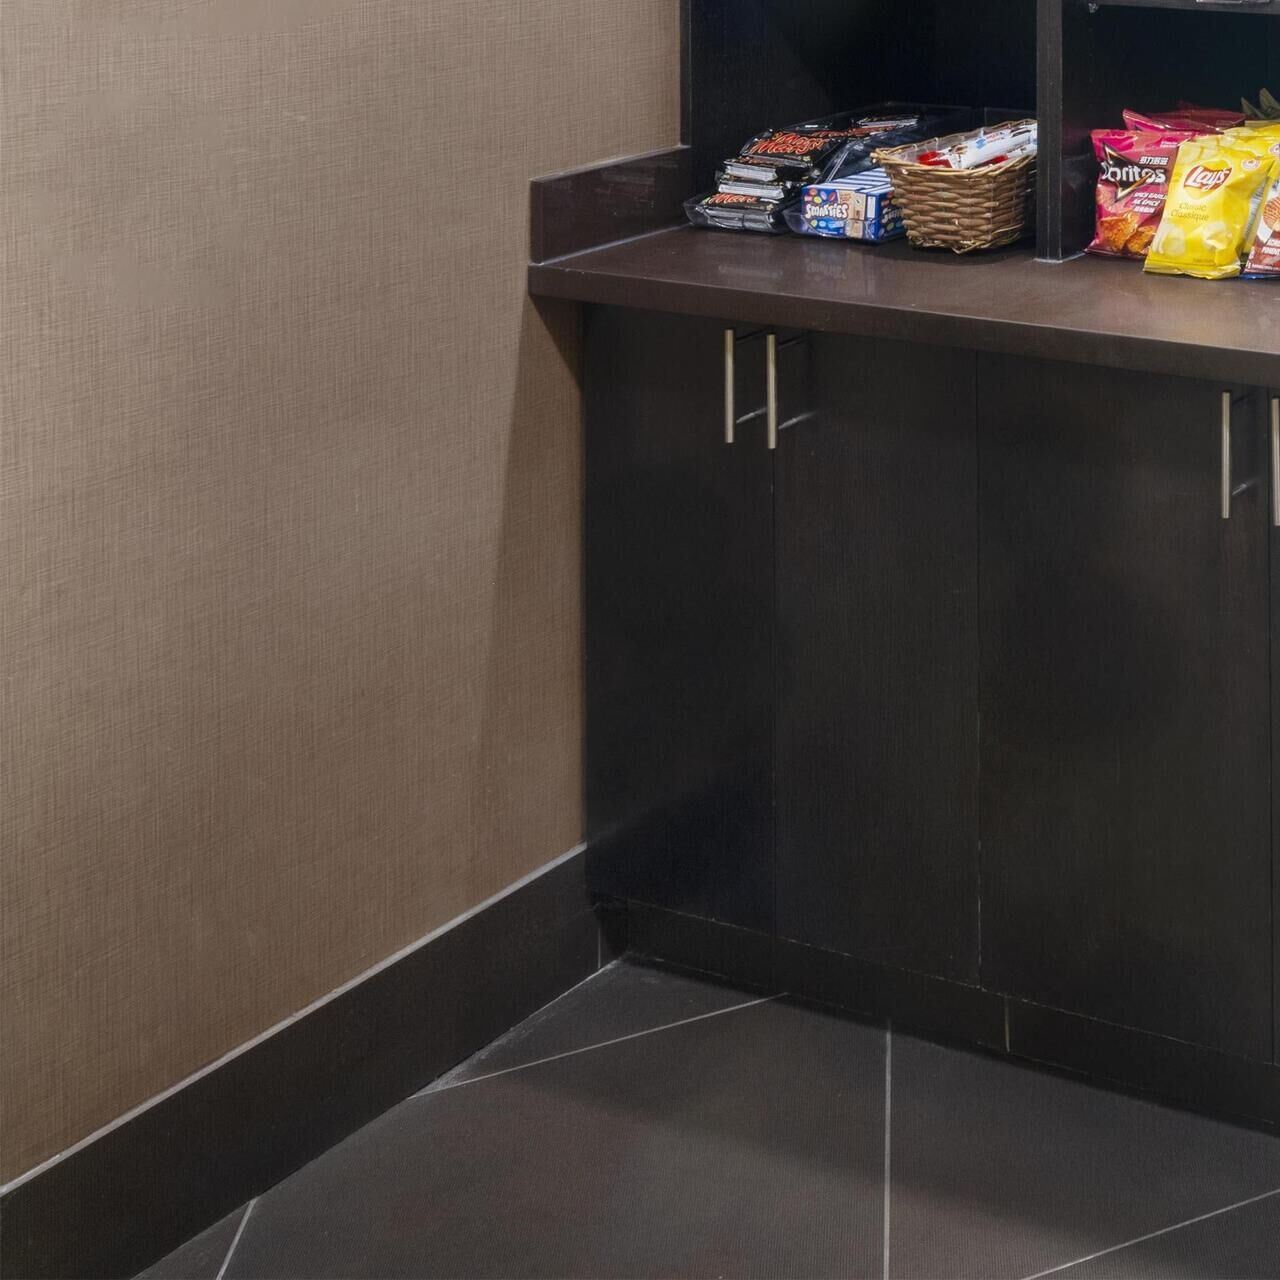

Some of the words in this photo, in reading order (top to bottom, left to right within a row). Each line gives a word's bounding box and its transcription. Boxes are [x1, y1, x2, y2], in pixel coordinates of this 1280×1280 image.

[1101, 160, 1167, 184] Doritos
[1184, 166, 1232, 192] Lay's
[804, 204, 849, 220] SMARTIES
[1170, 209, 1211, 222] Classique
